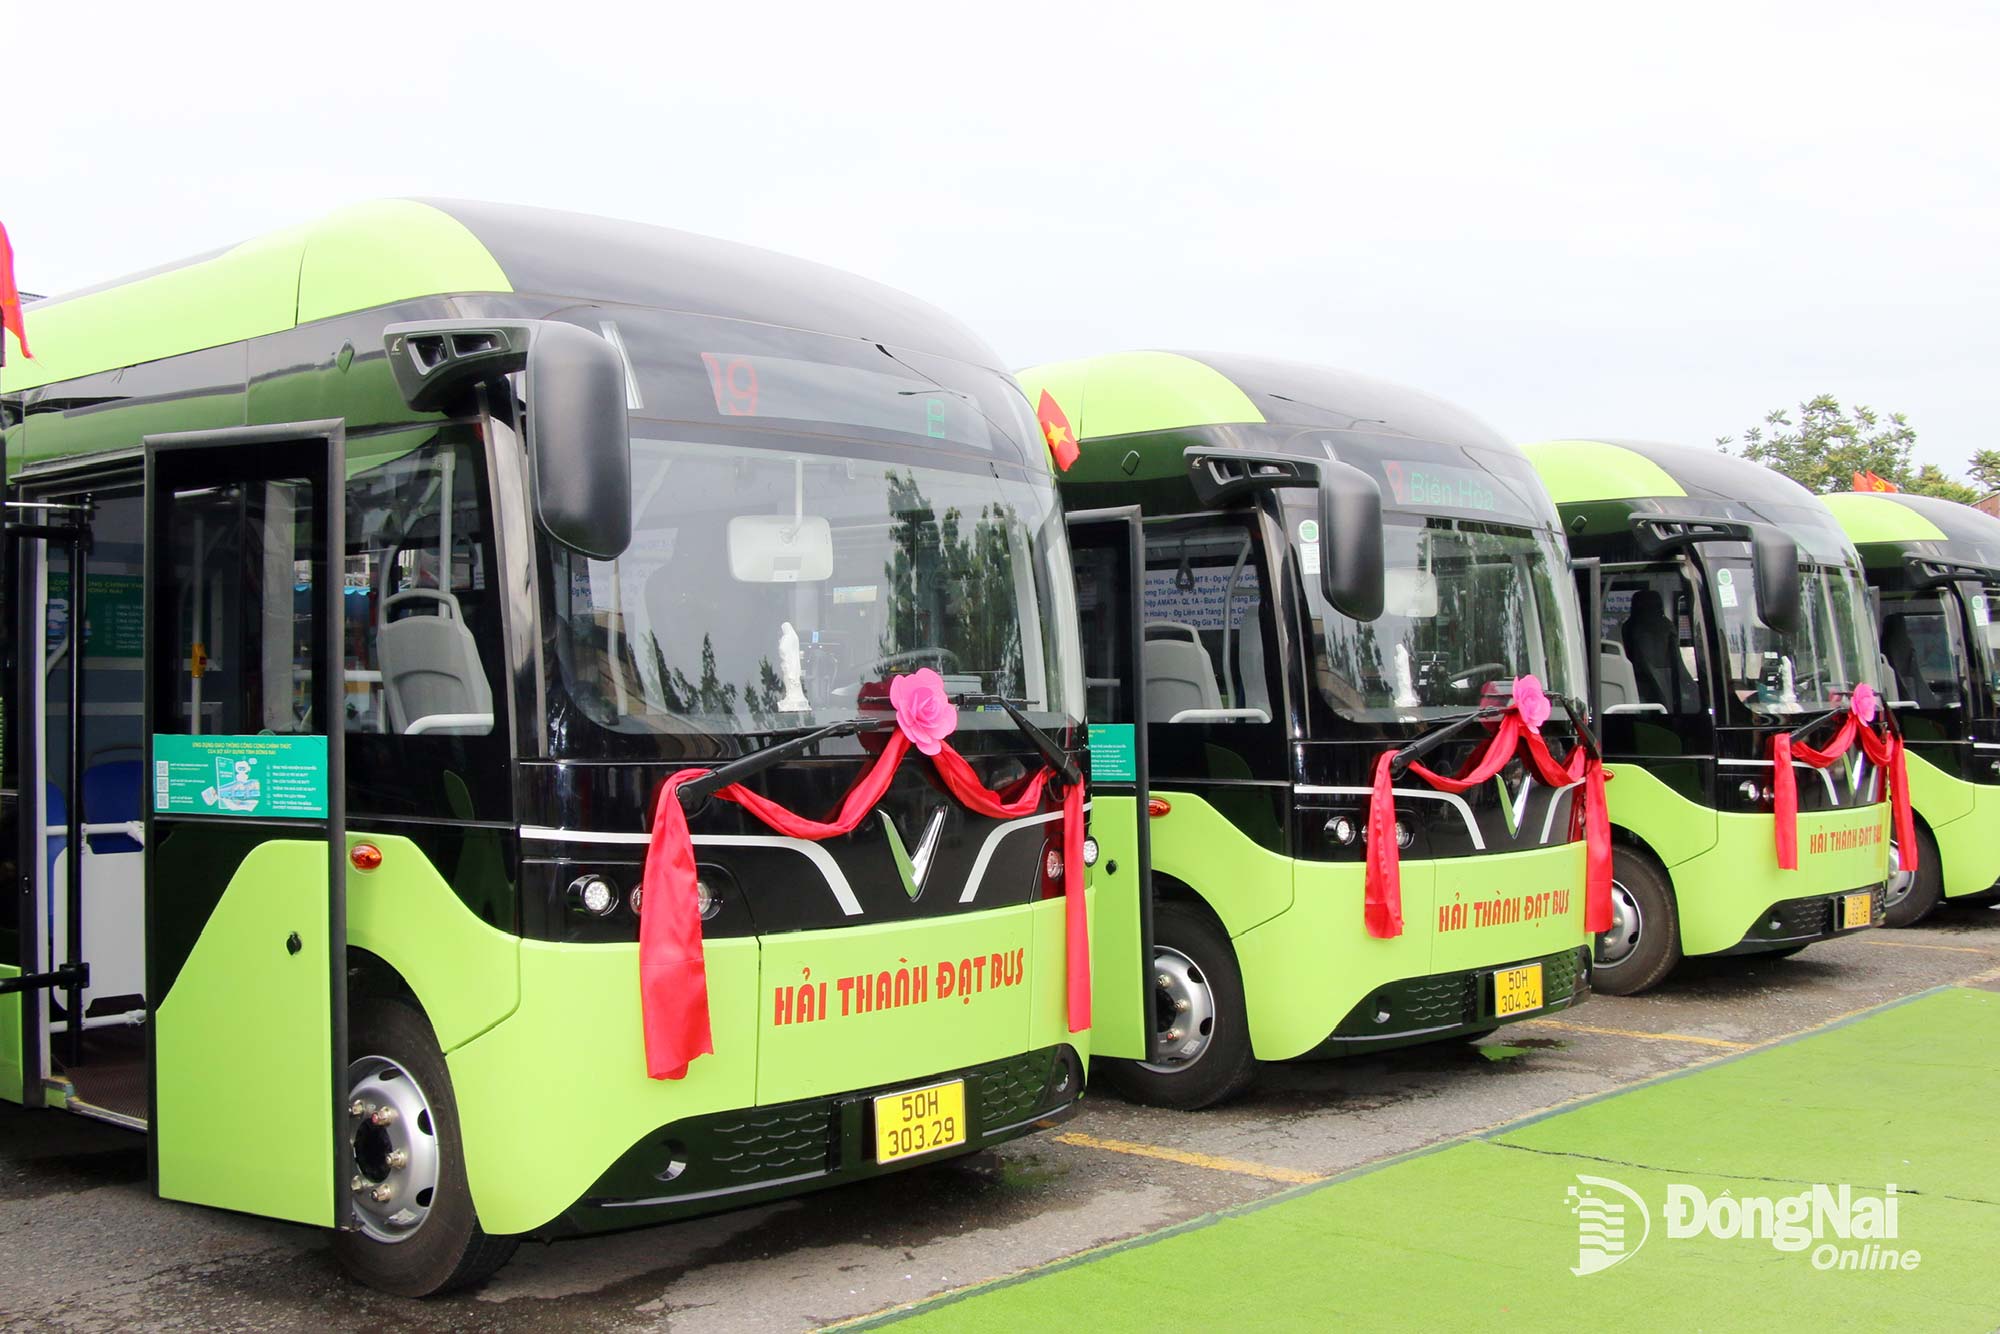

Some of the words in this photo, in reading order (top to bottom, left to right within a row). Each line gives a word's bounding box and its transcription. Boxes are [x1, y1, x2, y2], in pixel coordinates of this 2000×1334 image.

[1411, 472, 1453, 505] Biên
[1810, 825, 1828, 854] HẢI
[1830, 824, 1858, 851] THÀNH
[1439, 892, 1468, 932] HẢI
[1473, 890, 1521, 928] THÀNH
[1524, 892, 1551, 928] ĐẠT
[1552, 889, 1570, 915] BUS
[774, 967, 827, 1026] HẢI
[837, 957, 928, 1017] THÀNH
[936, 955, 987, 1005] ĐẠT
[990, 948, 1024, 989] BUS
[1508, 969, 1529, 991] 50H
[1501, 989, 1537, 1014] 304.34
[902, 1090, 939, 1122] 50H
[888, 1116, 955, 1156] 303.29
